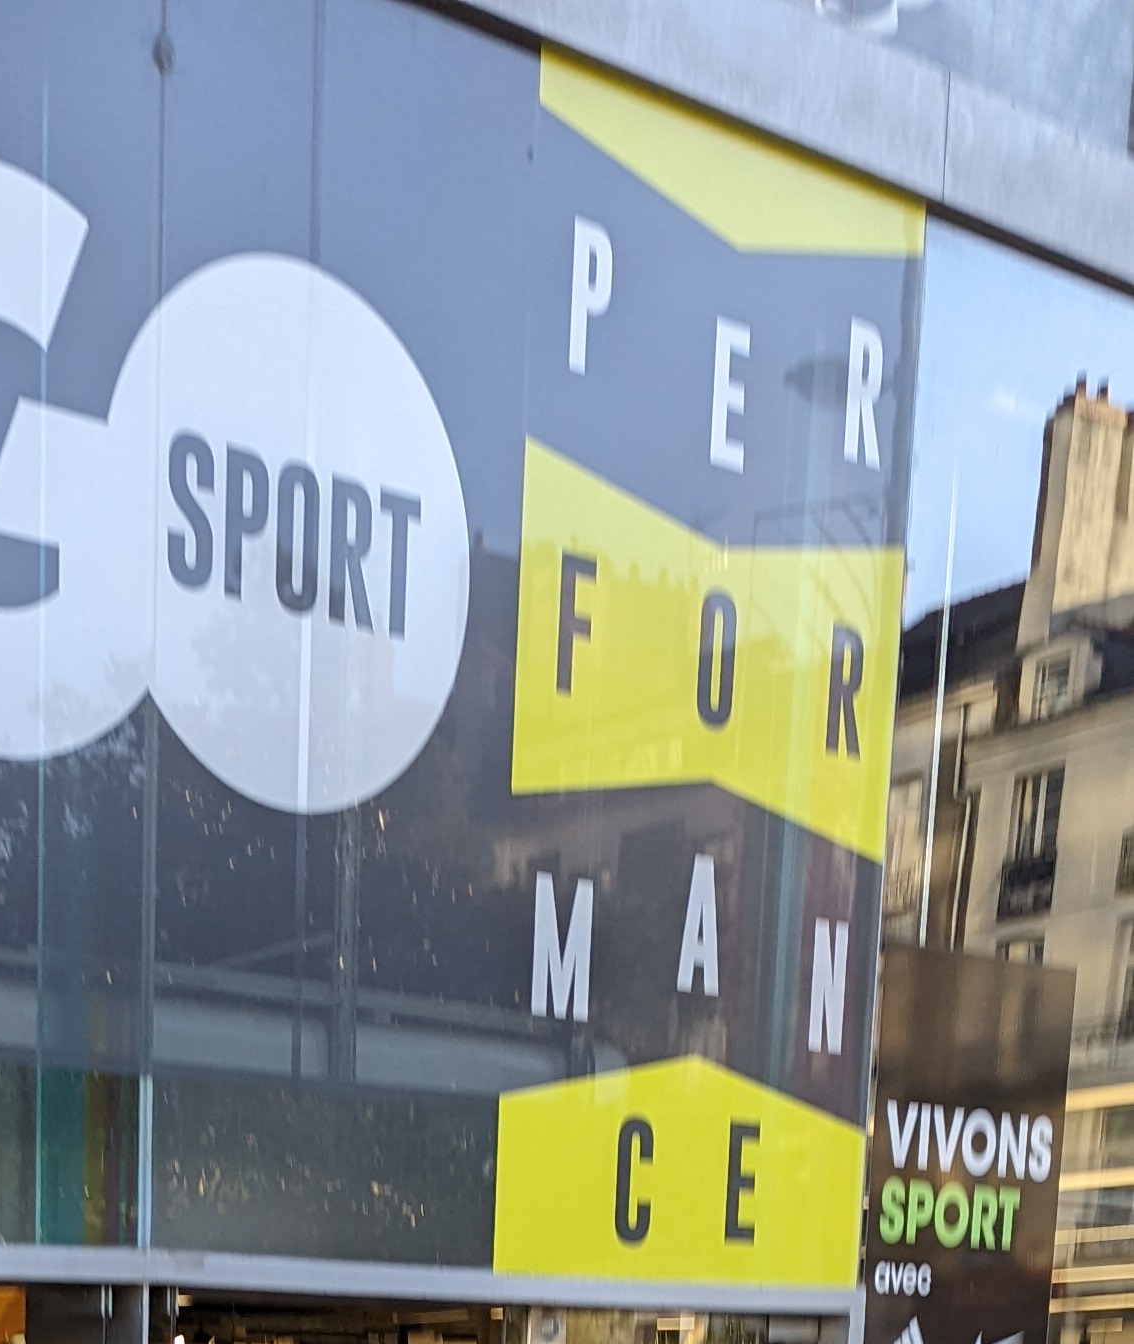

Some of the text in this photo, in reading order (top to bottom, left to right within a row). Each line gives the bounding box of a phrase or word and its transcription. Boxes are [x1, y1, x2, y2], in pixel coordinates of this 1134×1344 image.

[167, 429, 421, 641] SPORT
[887, 1100, 1053, 1182] VIVONS
[879, 1178, 1020, 1251] SPORT
